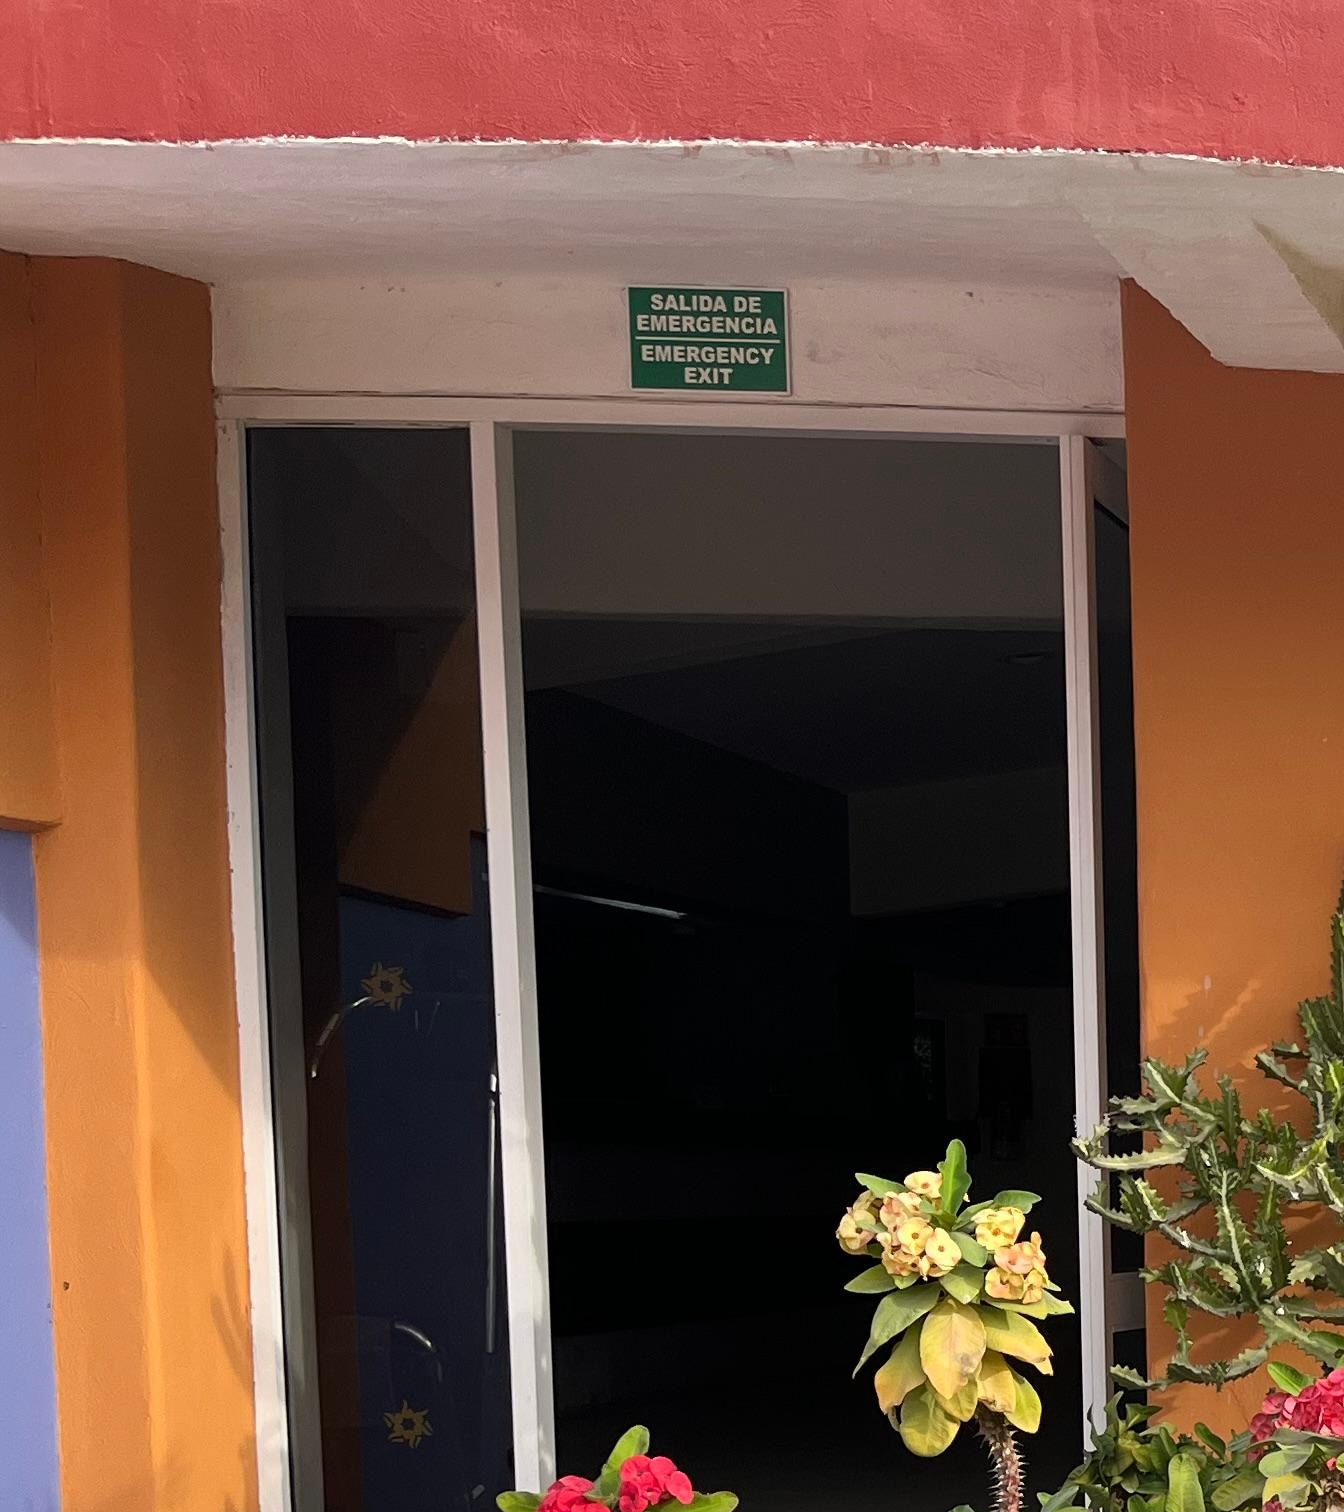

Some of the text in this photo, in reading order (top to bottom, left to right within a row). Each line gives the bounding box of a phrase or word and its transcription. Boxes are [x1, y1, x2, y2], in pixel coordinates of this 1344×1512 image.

[650, 293, 763, 314] SALIDA DE
[636, 314, 778, 335] EMERGENCIA
[641, 344, 775, 365] EMERGENCY
[684, 367, 734, 385] EXIT
